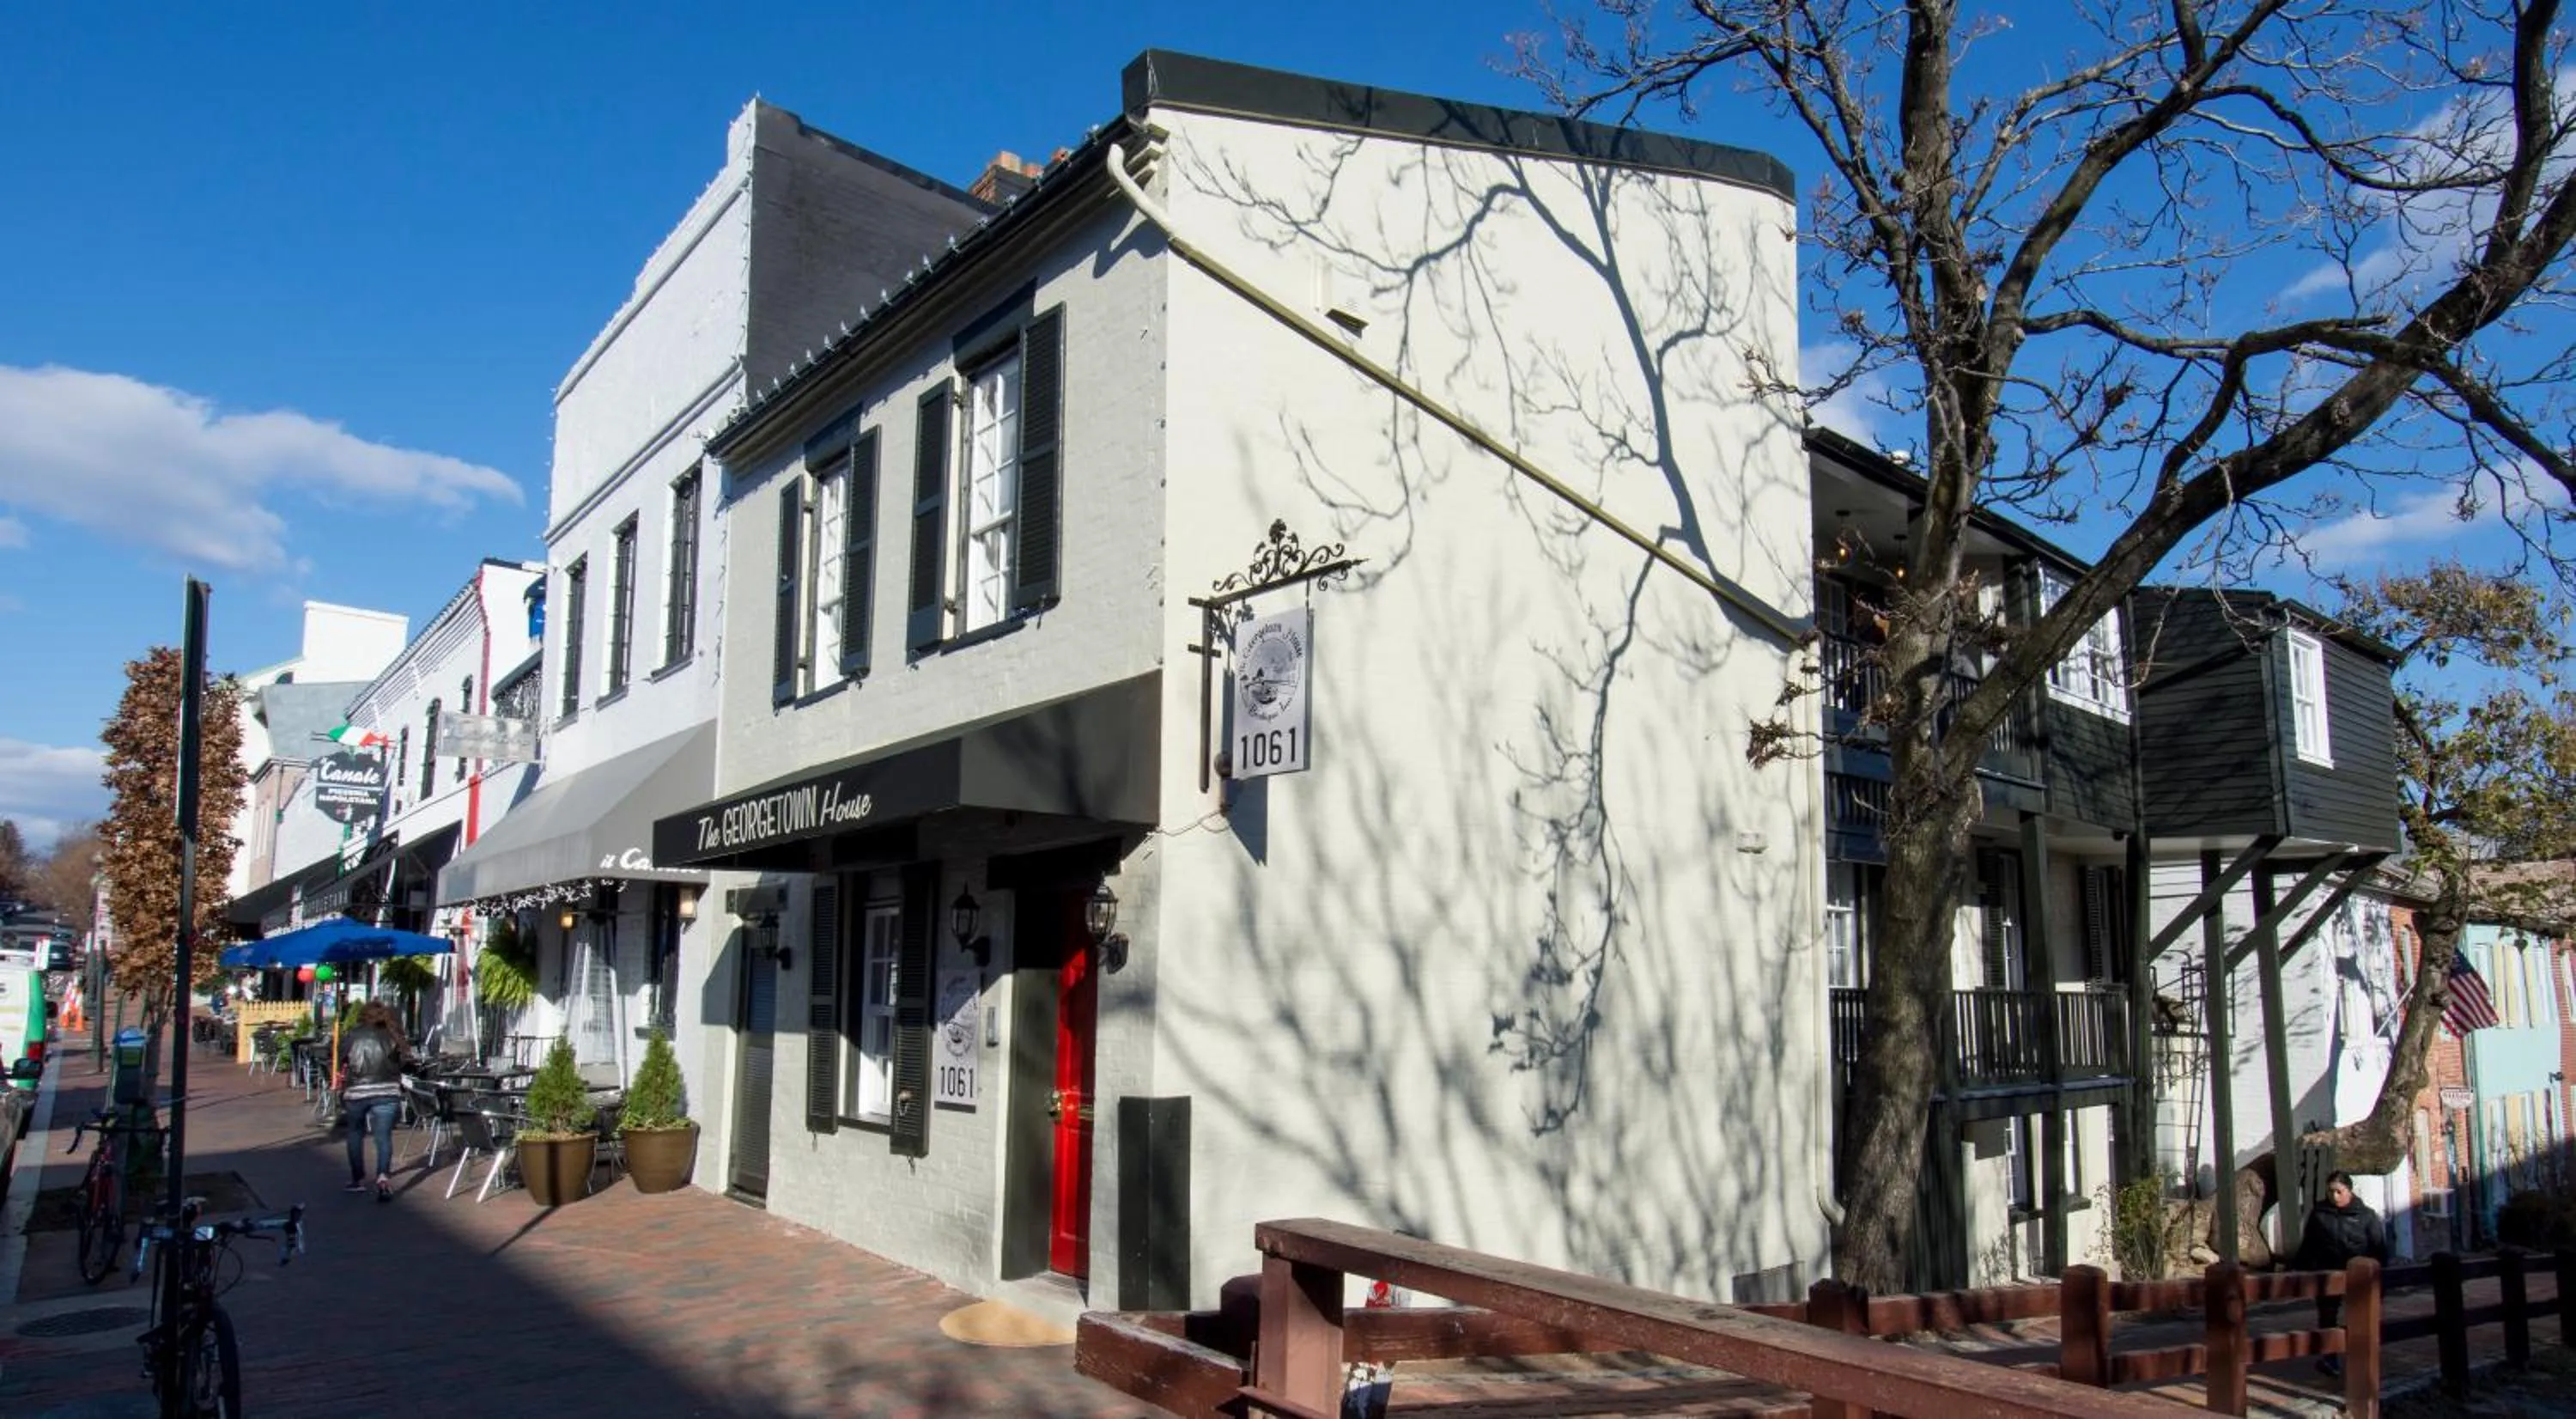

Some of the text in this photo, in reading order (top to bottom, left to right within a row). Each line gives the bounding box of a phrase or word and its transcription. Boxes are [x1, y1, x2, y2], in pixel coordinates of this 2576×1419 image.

[1241, 727, 1297, 770] 1061
[320, 759, 380, 784] Canale
[696, 781, 872, 851] The GEORGETOWN House
[940, 1066, 974, 1099] 1061
